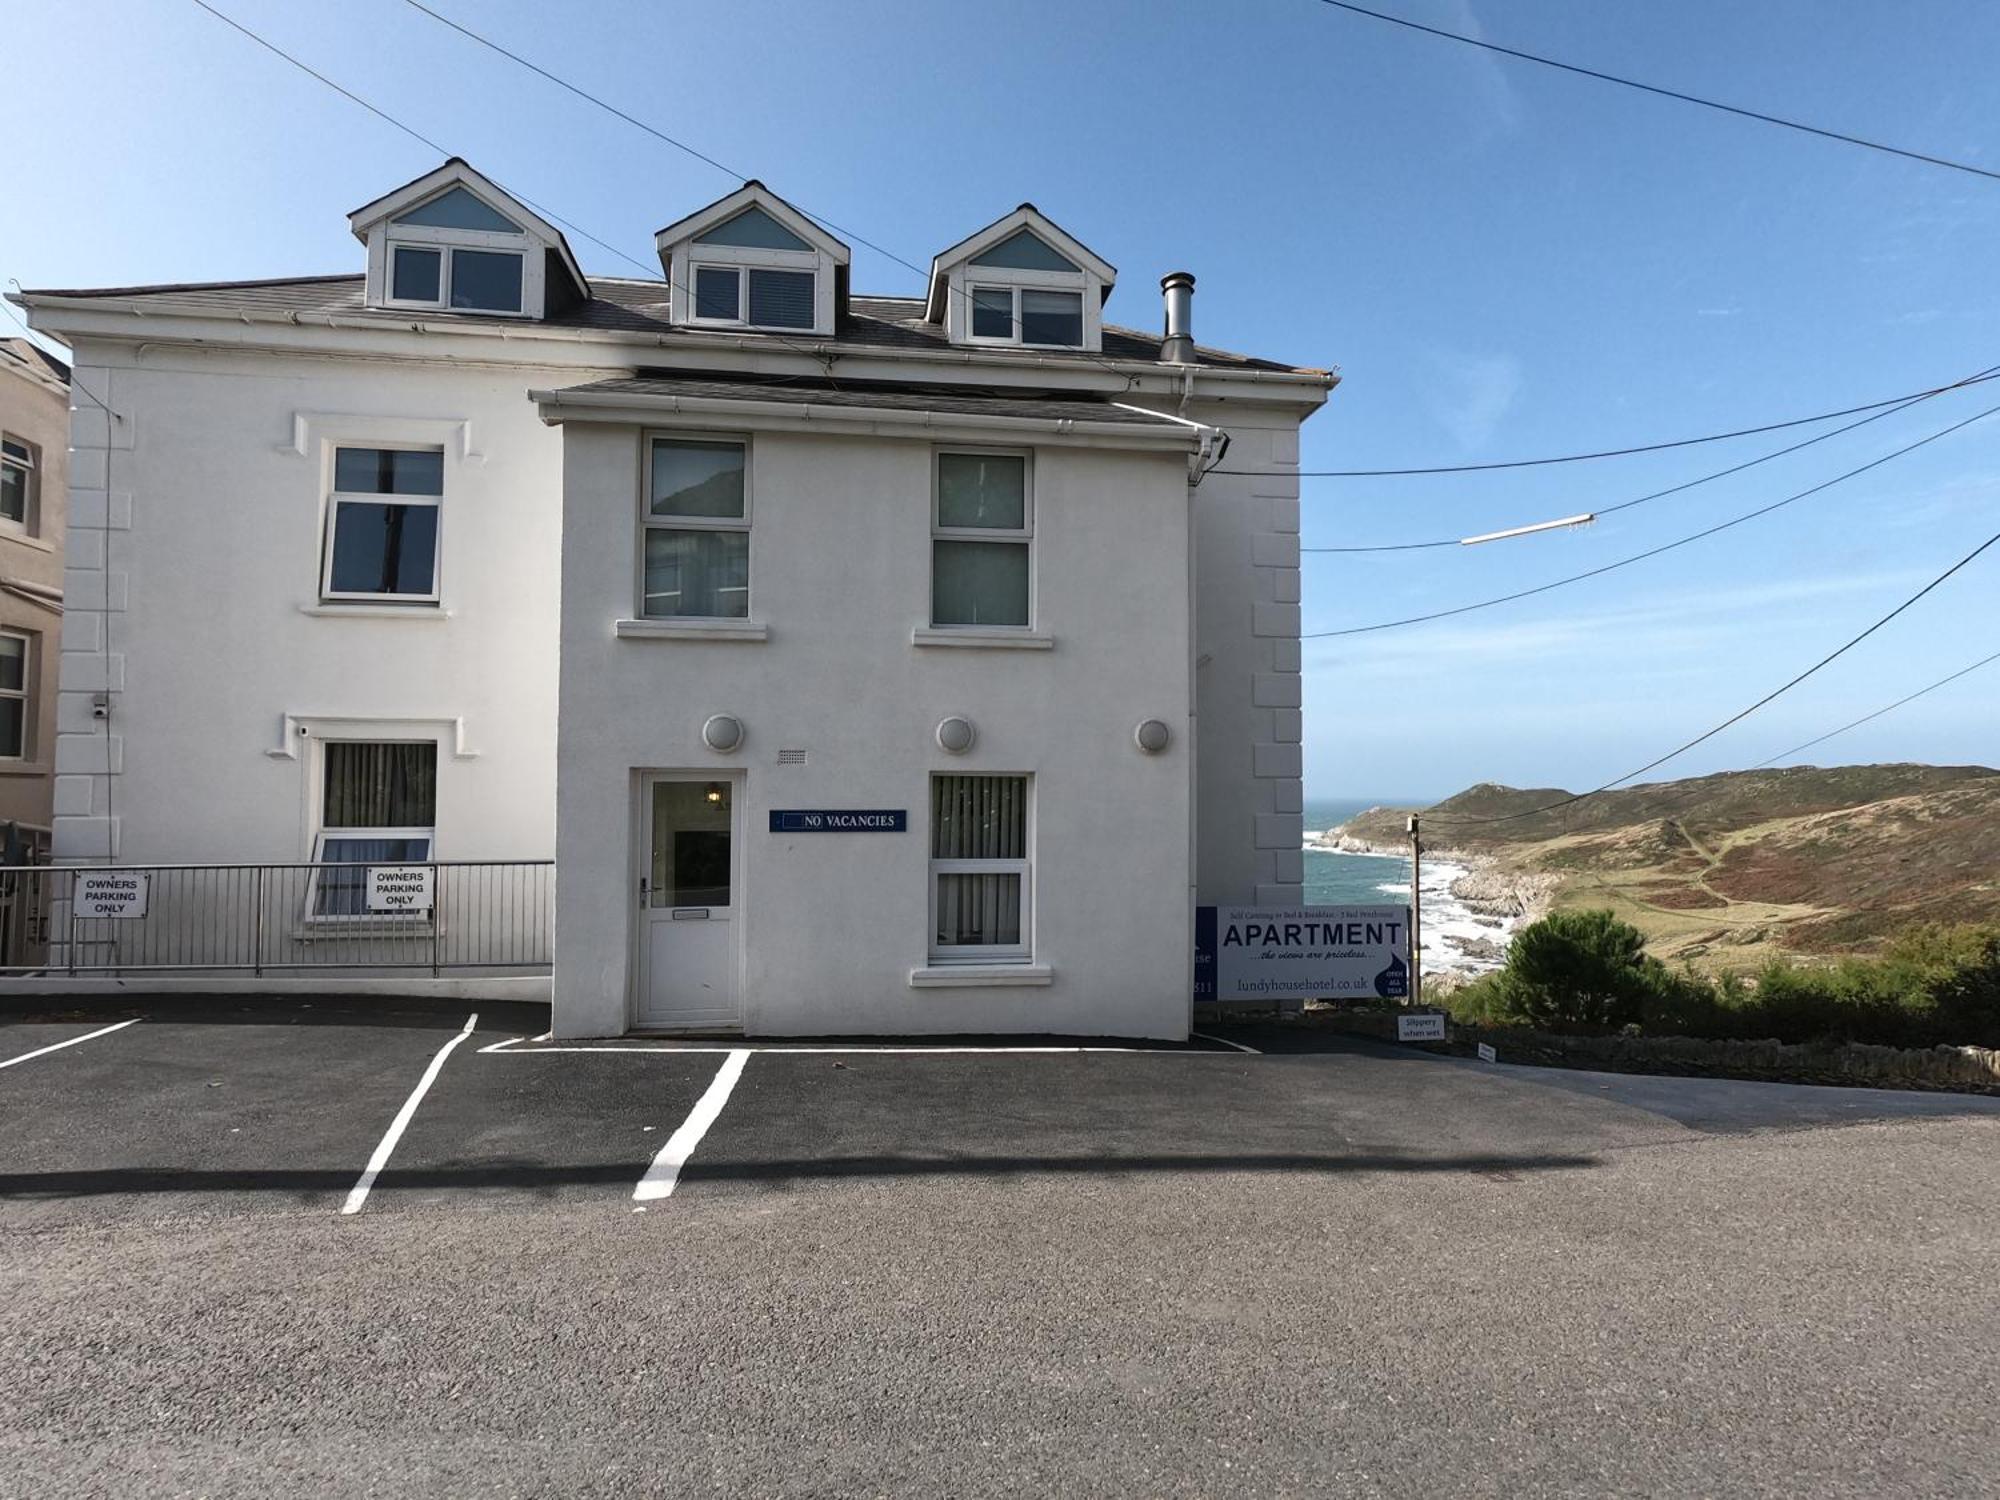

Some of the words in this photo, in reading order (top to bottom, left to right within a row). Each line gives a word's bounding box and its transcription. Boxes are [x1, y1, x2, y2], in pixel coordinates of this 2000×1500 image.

[804, 815, 821, 826] NO
[826, 815, 895, 827] VACANCIES
[376, 872, 424, 882] OWNERS
[86, 880, 137, 889] OWNERS
[376, 884, 424, 893] PARKING
[85, 892, 137, 901] PARKING
[386, 895, 414, 905] ONLY
[94, 904, 126, 913] ONLY
[1223, 923, 1402, 947] APARTMENT
[1306, 951, 1322, 959] are
[1237, 976, 1368, 994] lundyhousehotel.co.uk
[1406, 1018, 1437, 1028] Slippery
[1403, 1029, 1425, 1038] when
[1426, 1029, 1441, 1037] wet
